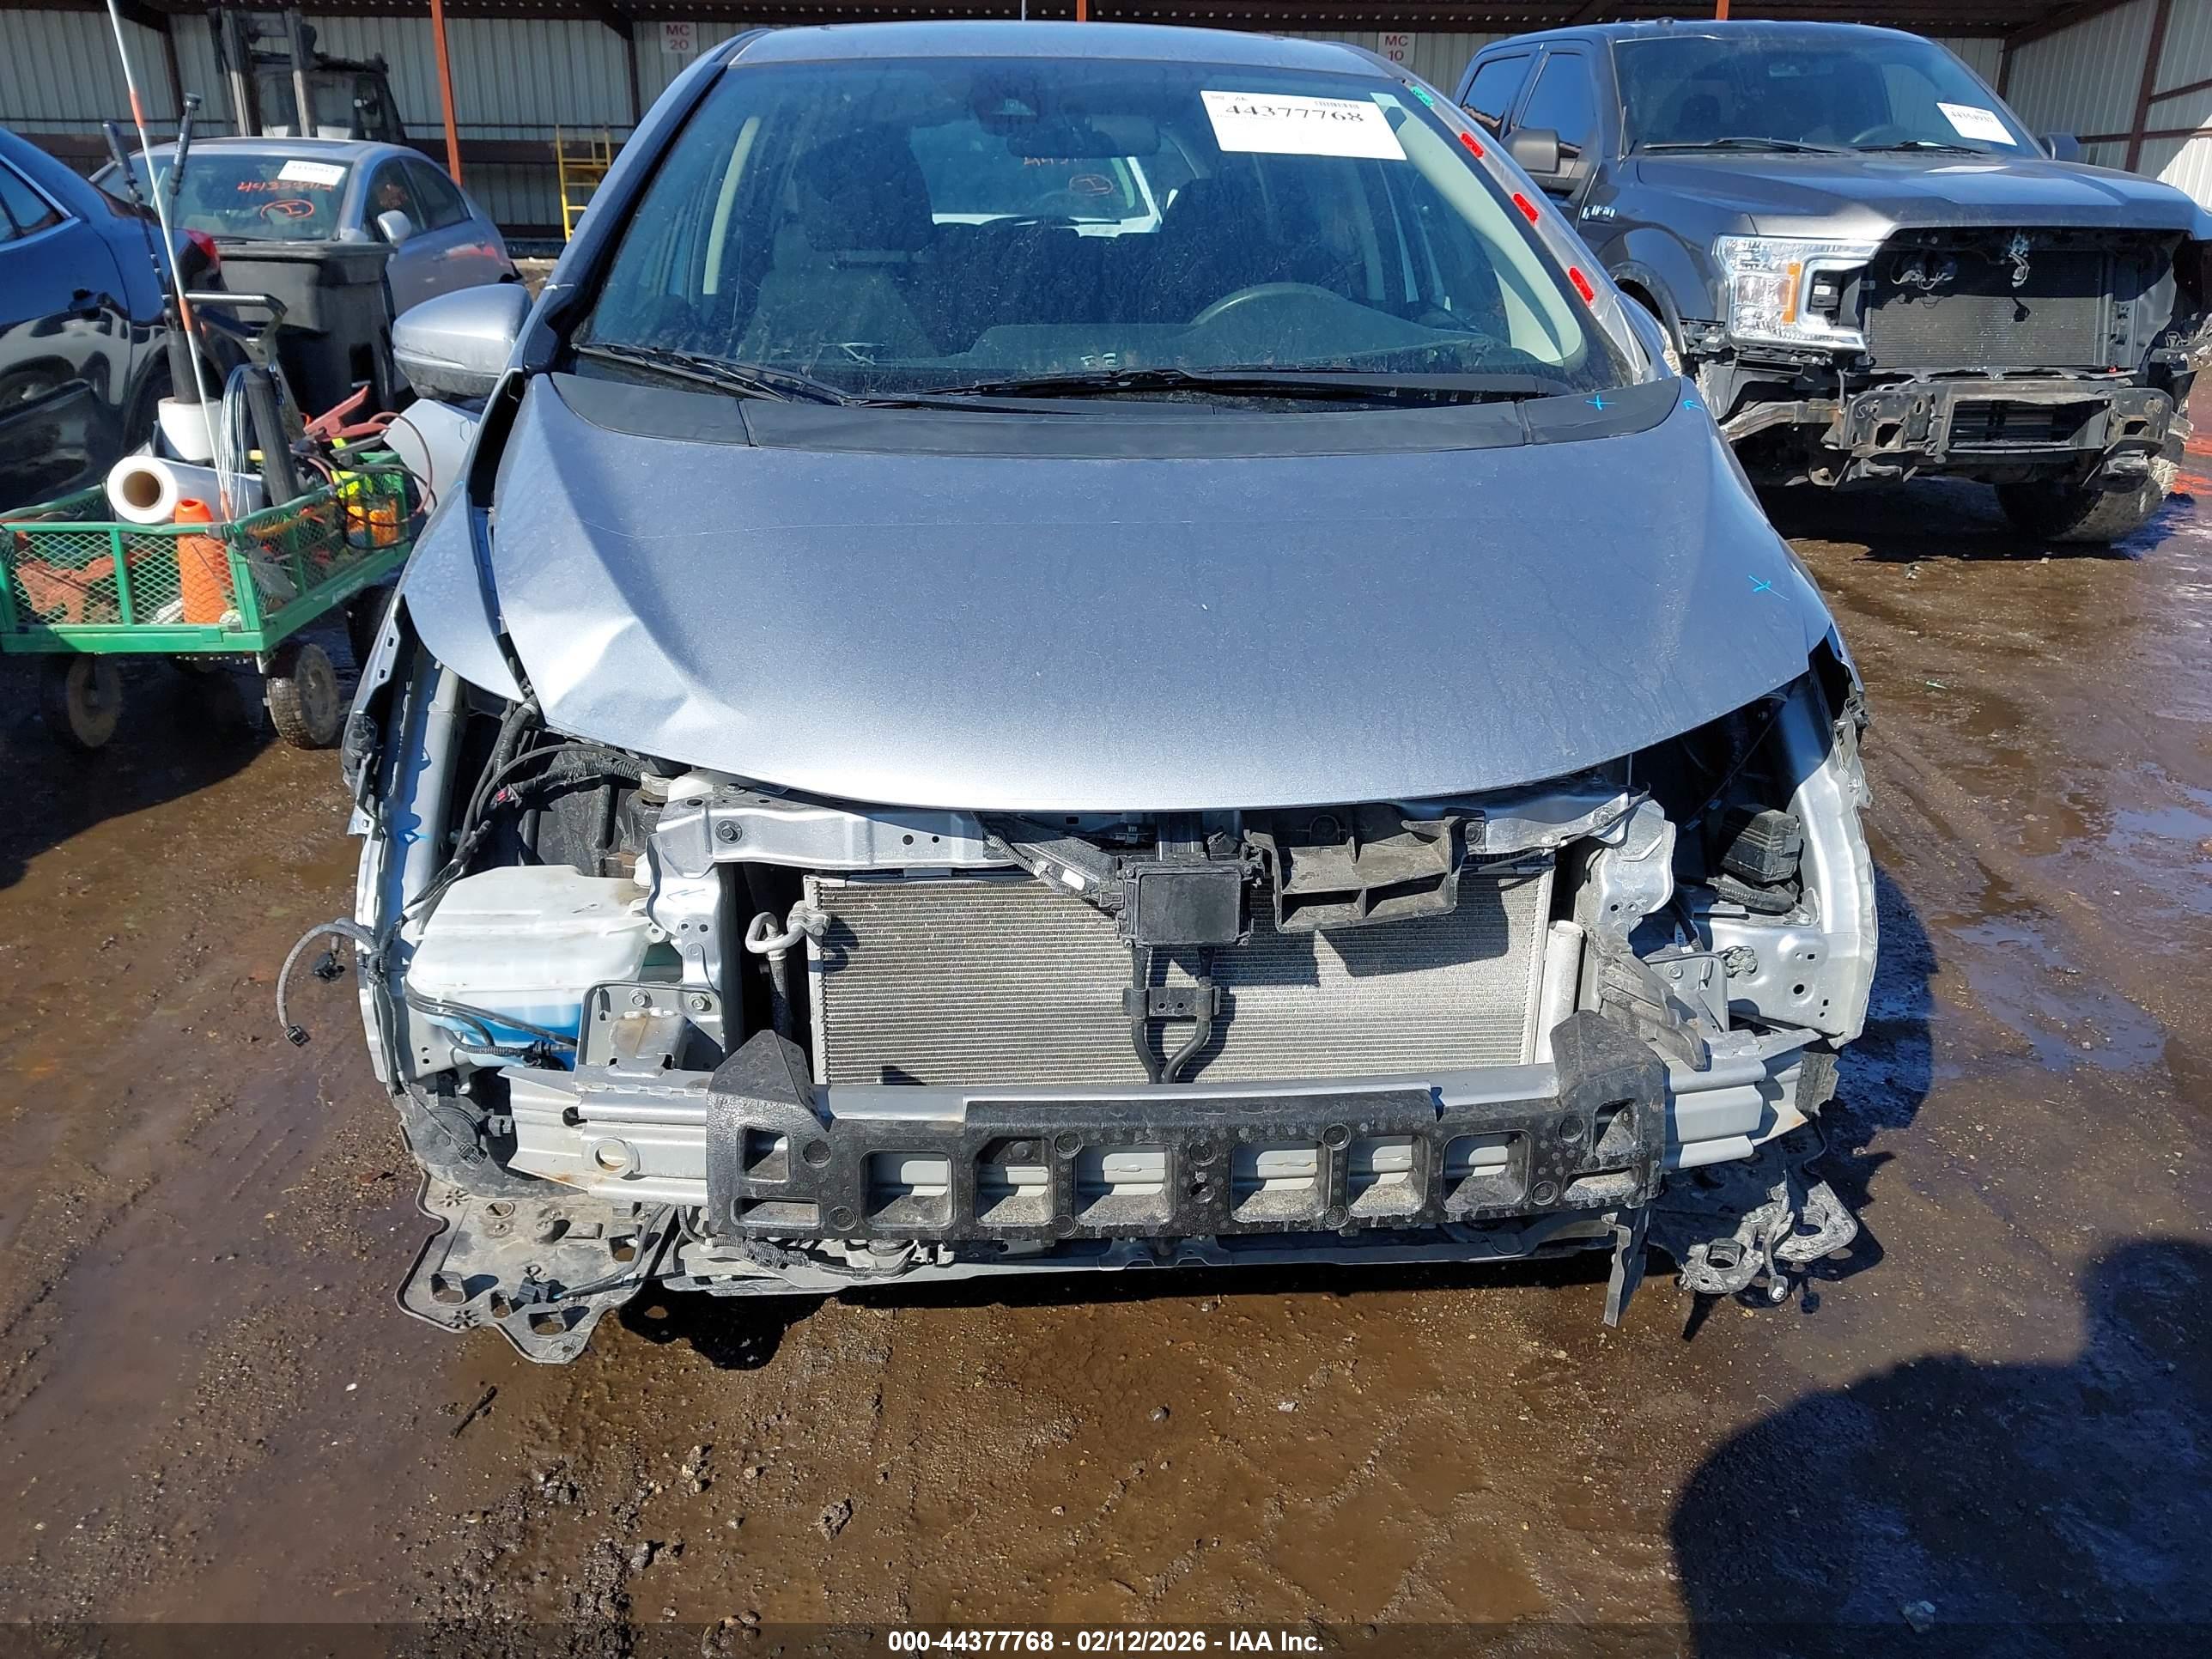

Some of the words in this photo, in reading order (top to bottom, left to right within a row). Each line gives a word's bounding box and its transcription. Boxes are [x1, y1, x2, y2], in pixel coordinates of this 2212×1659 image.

[665, 25, 690, 35] MC
[670, 40, 689, 51] 20
[1384, 35, 1408, 46] MC
[1388, 51, 1404, 61] 10
[1225, 105, 1364, 122] 44377768
